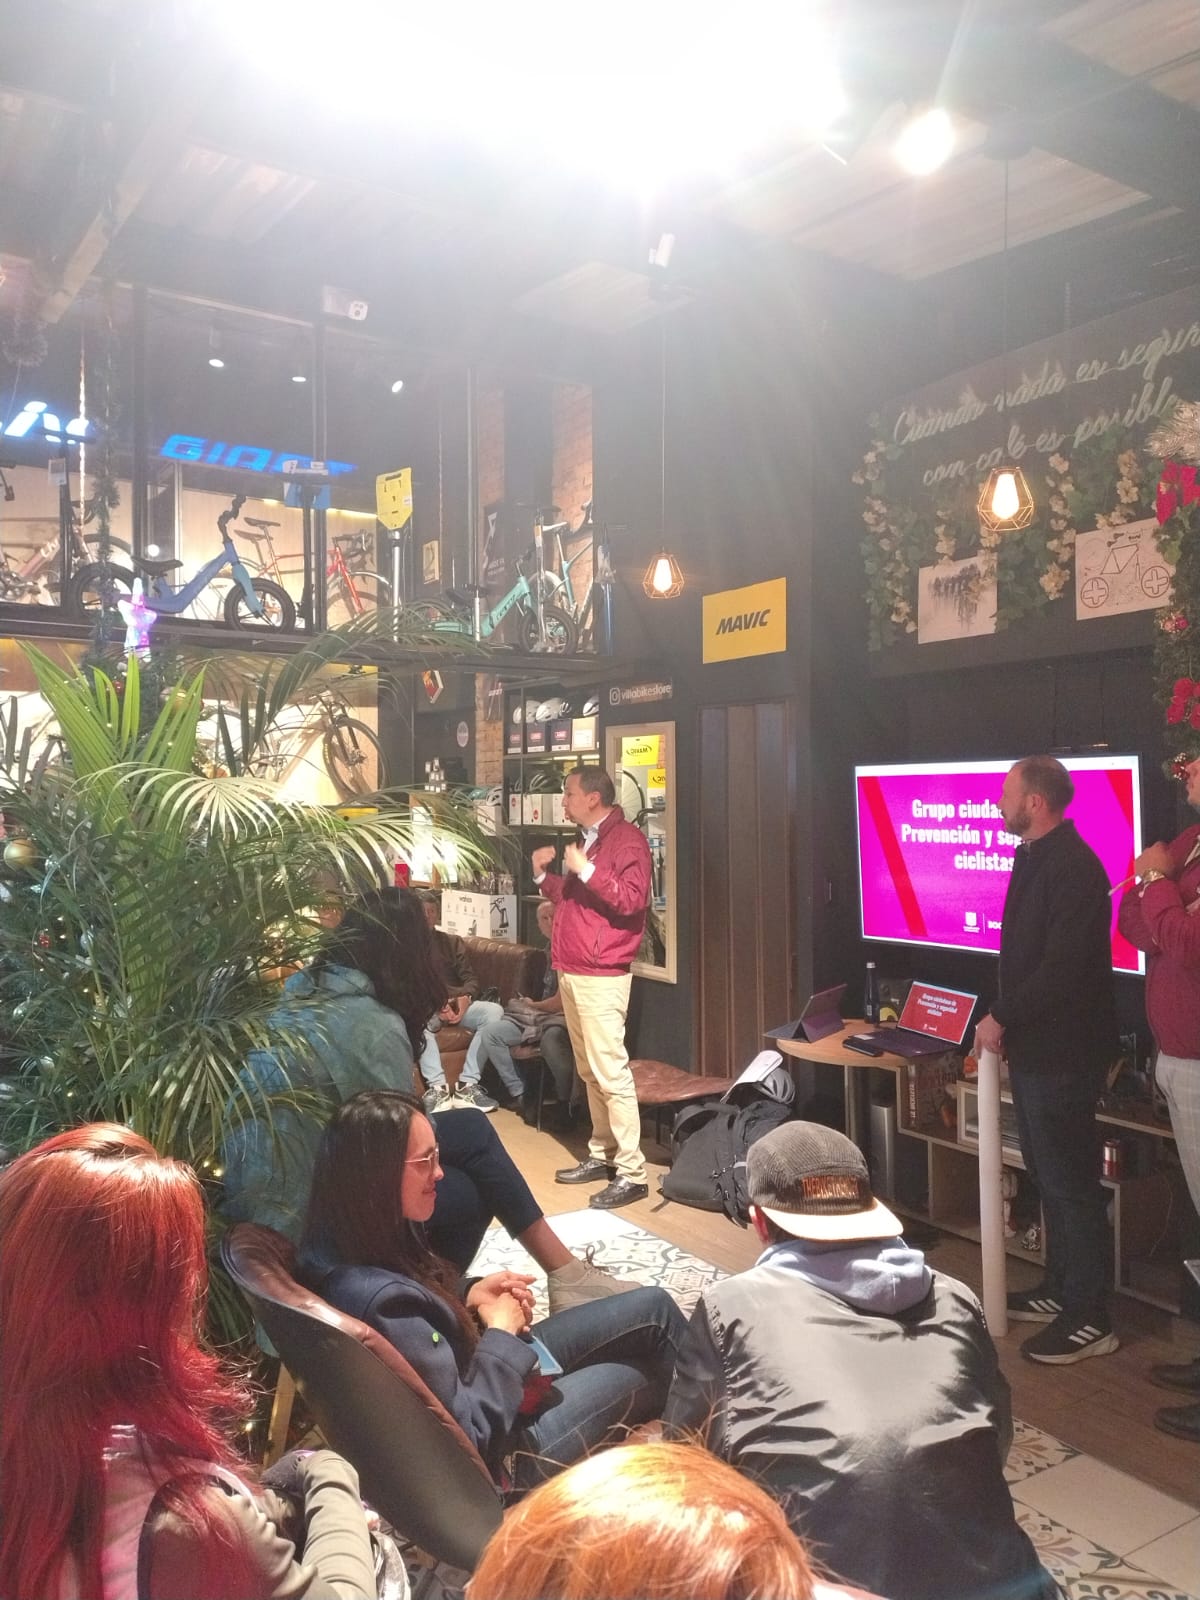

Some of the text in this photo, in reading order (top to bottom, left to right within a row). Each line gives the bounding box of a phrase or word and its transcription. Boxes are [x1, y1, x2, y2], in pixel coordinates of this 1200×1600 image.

[993, 361, 1067, 411] nada
[715, 608, 771, 635] MAVIC
[912, 799, 1004, 822] Grupo ciuda
[901, 823, 981, 845] Prevención
[983, 829, 994, 849] y
